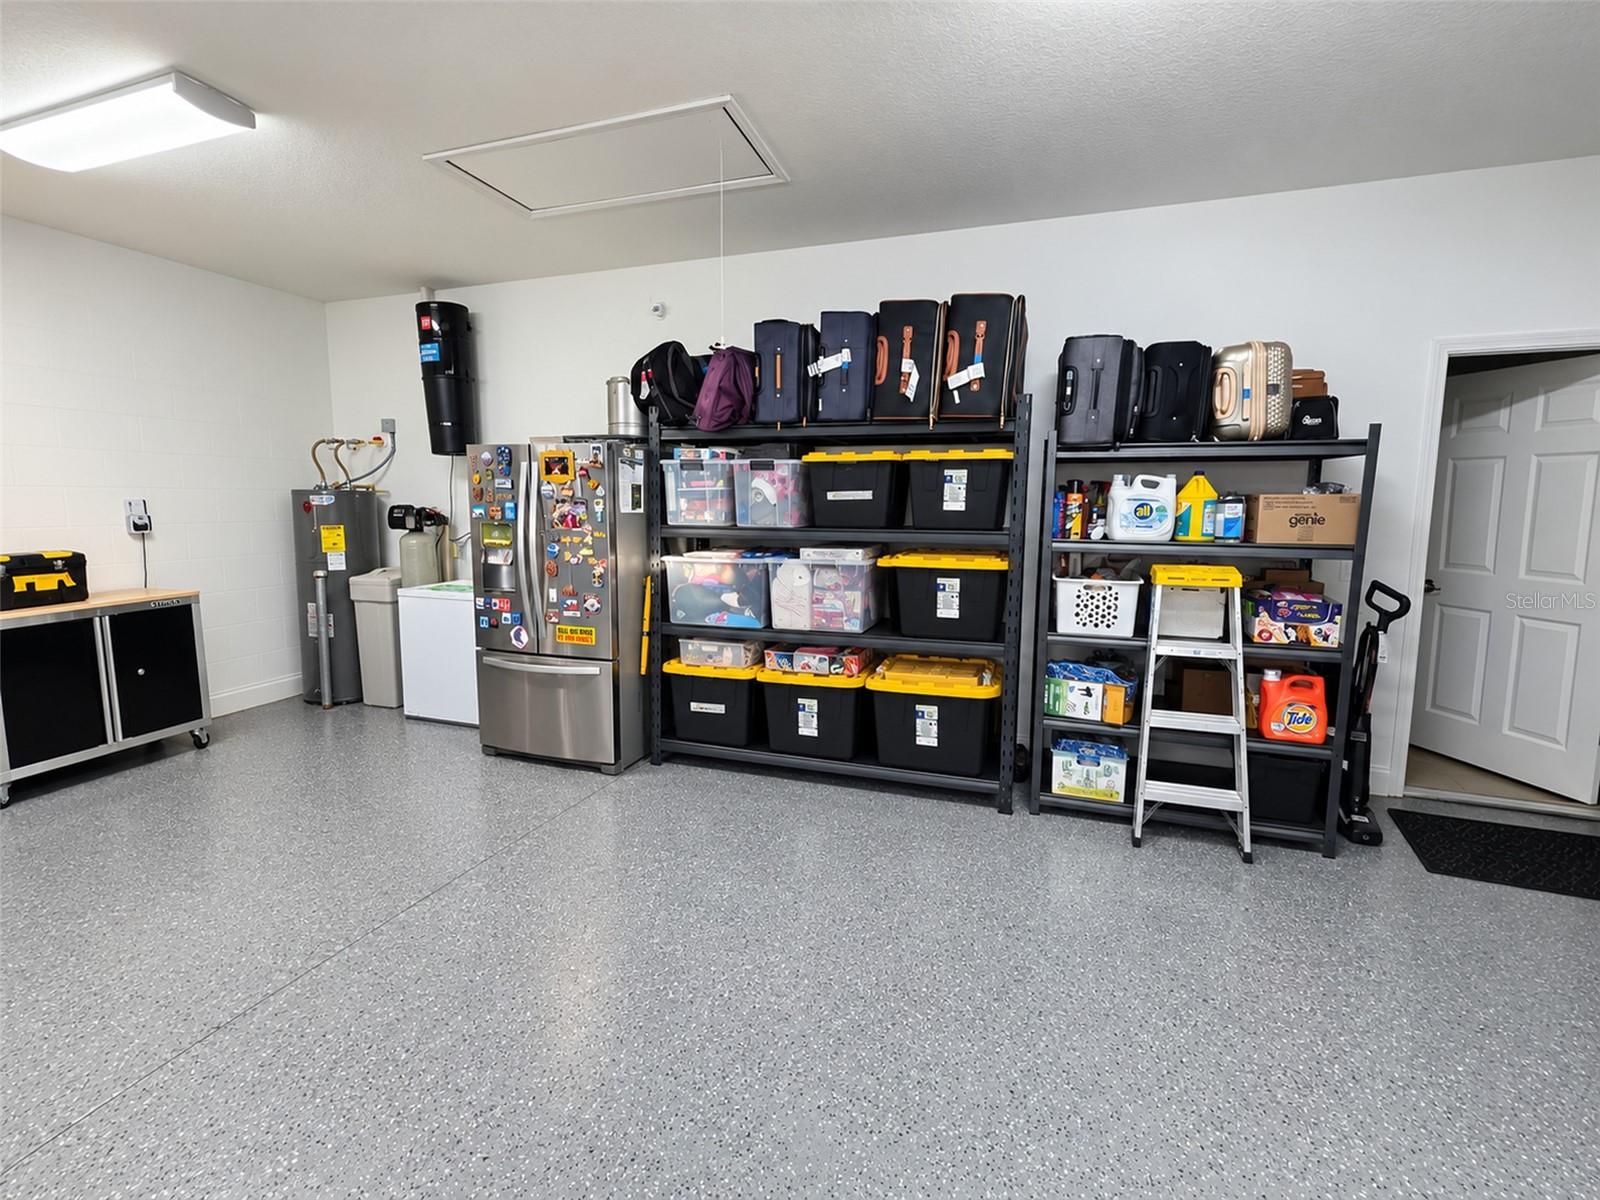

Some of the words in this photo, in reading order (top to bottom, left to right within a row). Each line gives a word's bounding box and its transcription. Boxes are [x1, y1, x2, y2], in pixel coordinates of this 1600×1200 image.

[1136, 505, 1150, 517] all
[1288, 512, 1326, 528] genie
[1287, 711, 1313, 726] Tide
